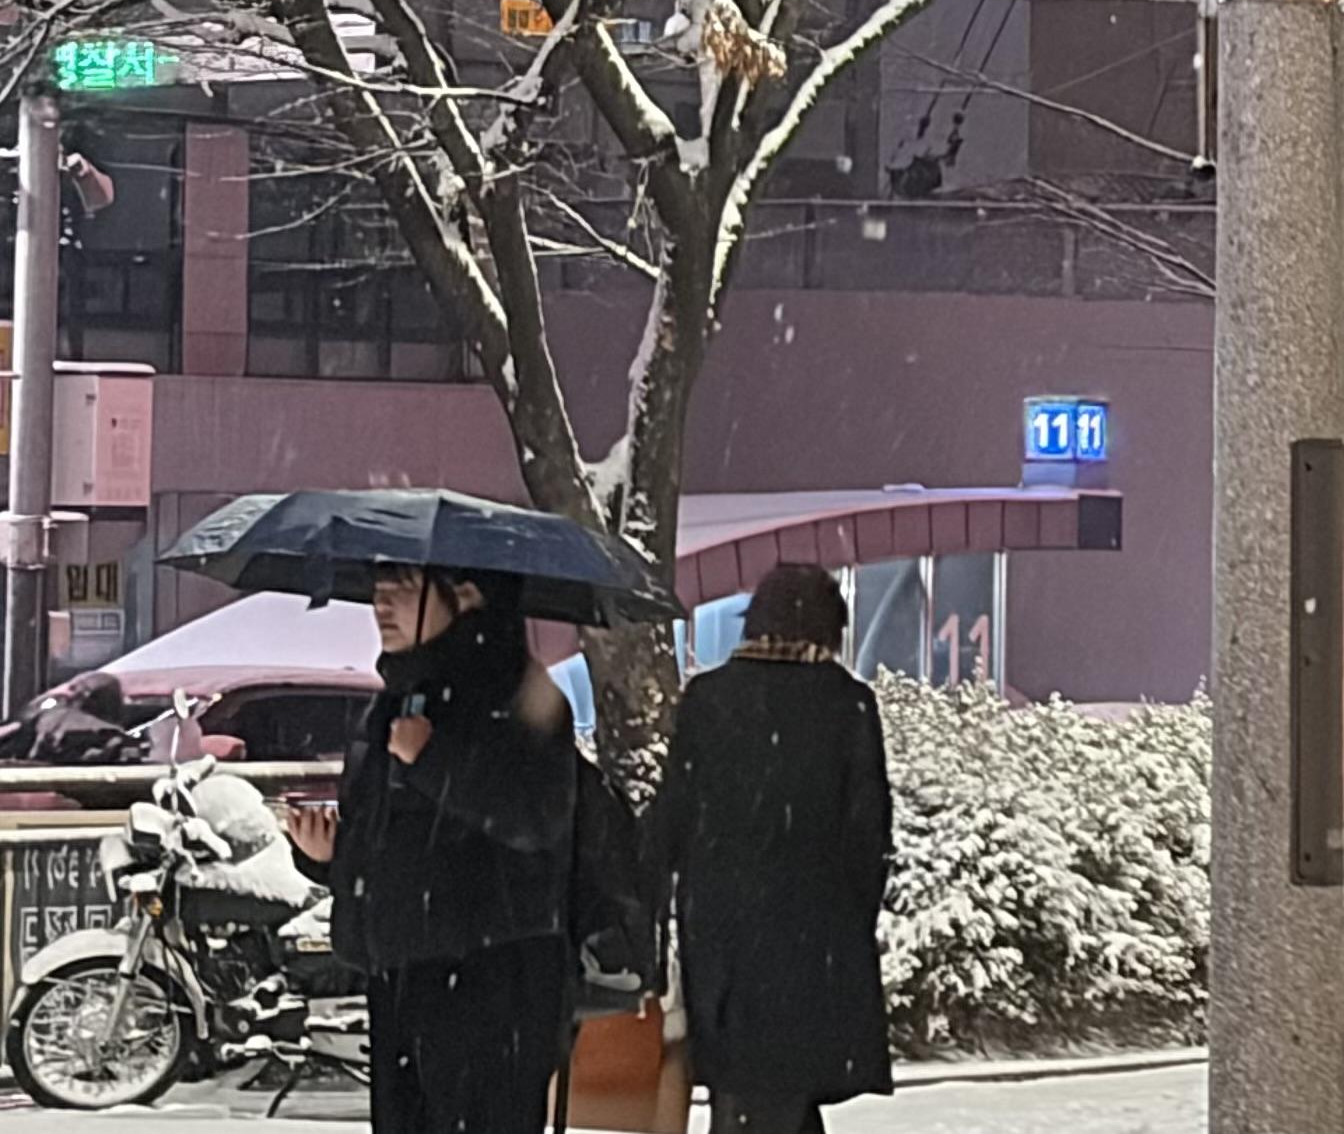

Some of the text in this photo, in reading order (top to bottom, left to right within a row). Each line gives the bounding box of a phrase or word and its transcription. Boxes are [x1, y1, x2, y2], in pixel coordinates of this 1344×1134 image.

[1033, 412, 1068, 448] 11
[1078, 413, 1101, 450] 11
[939, 613, 989, 686] 11
